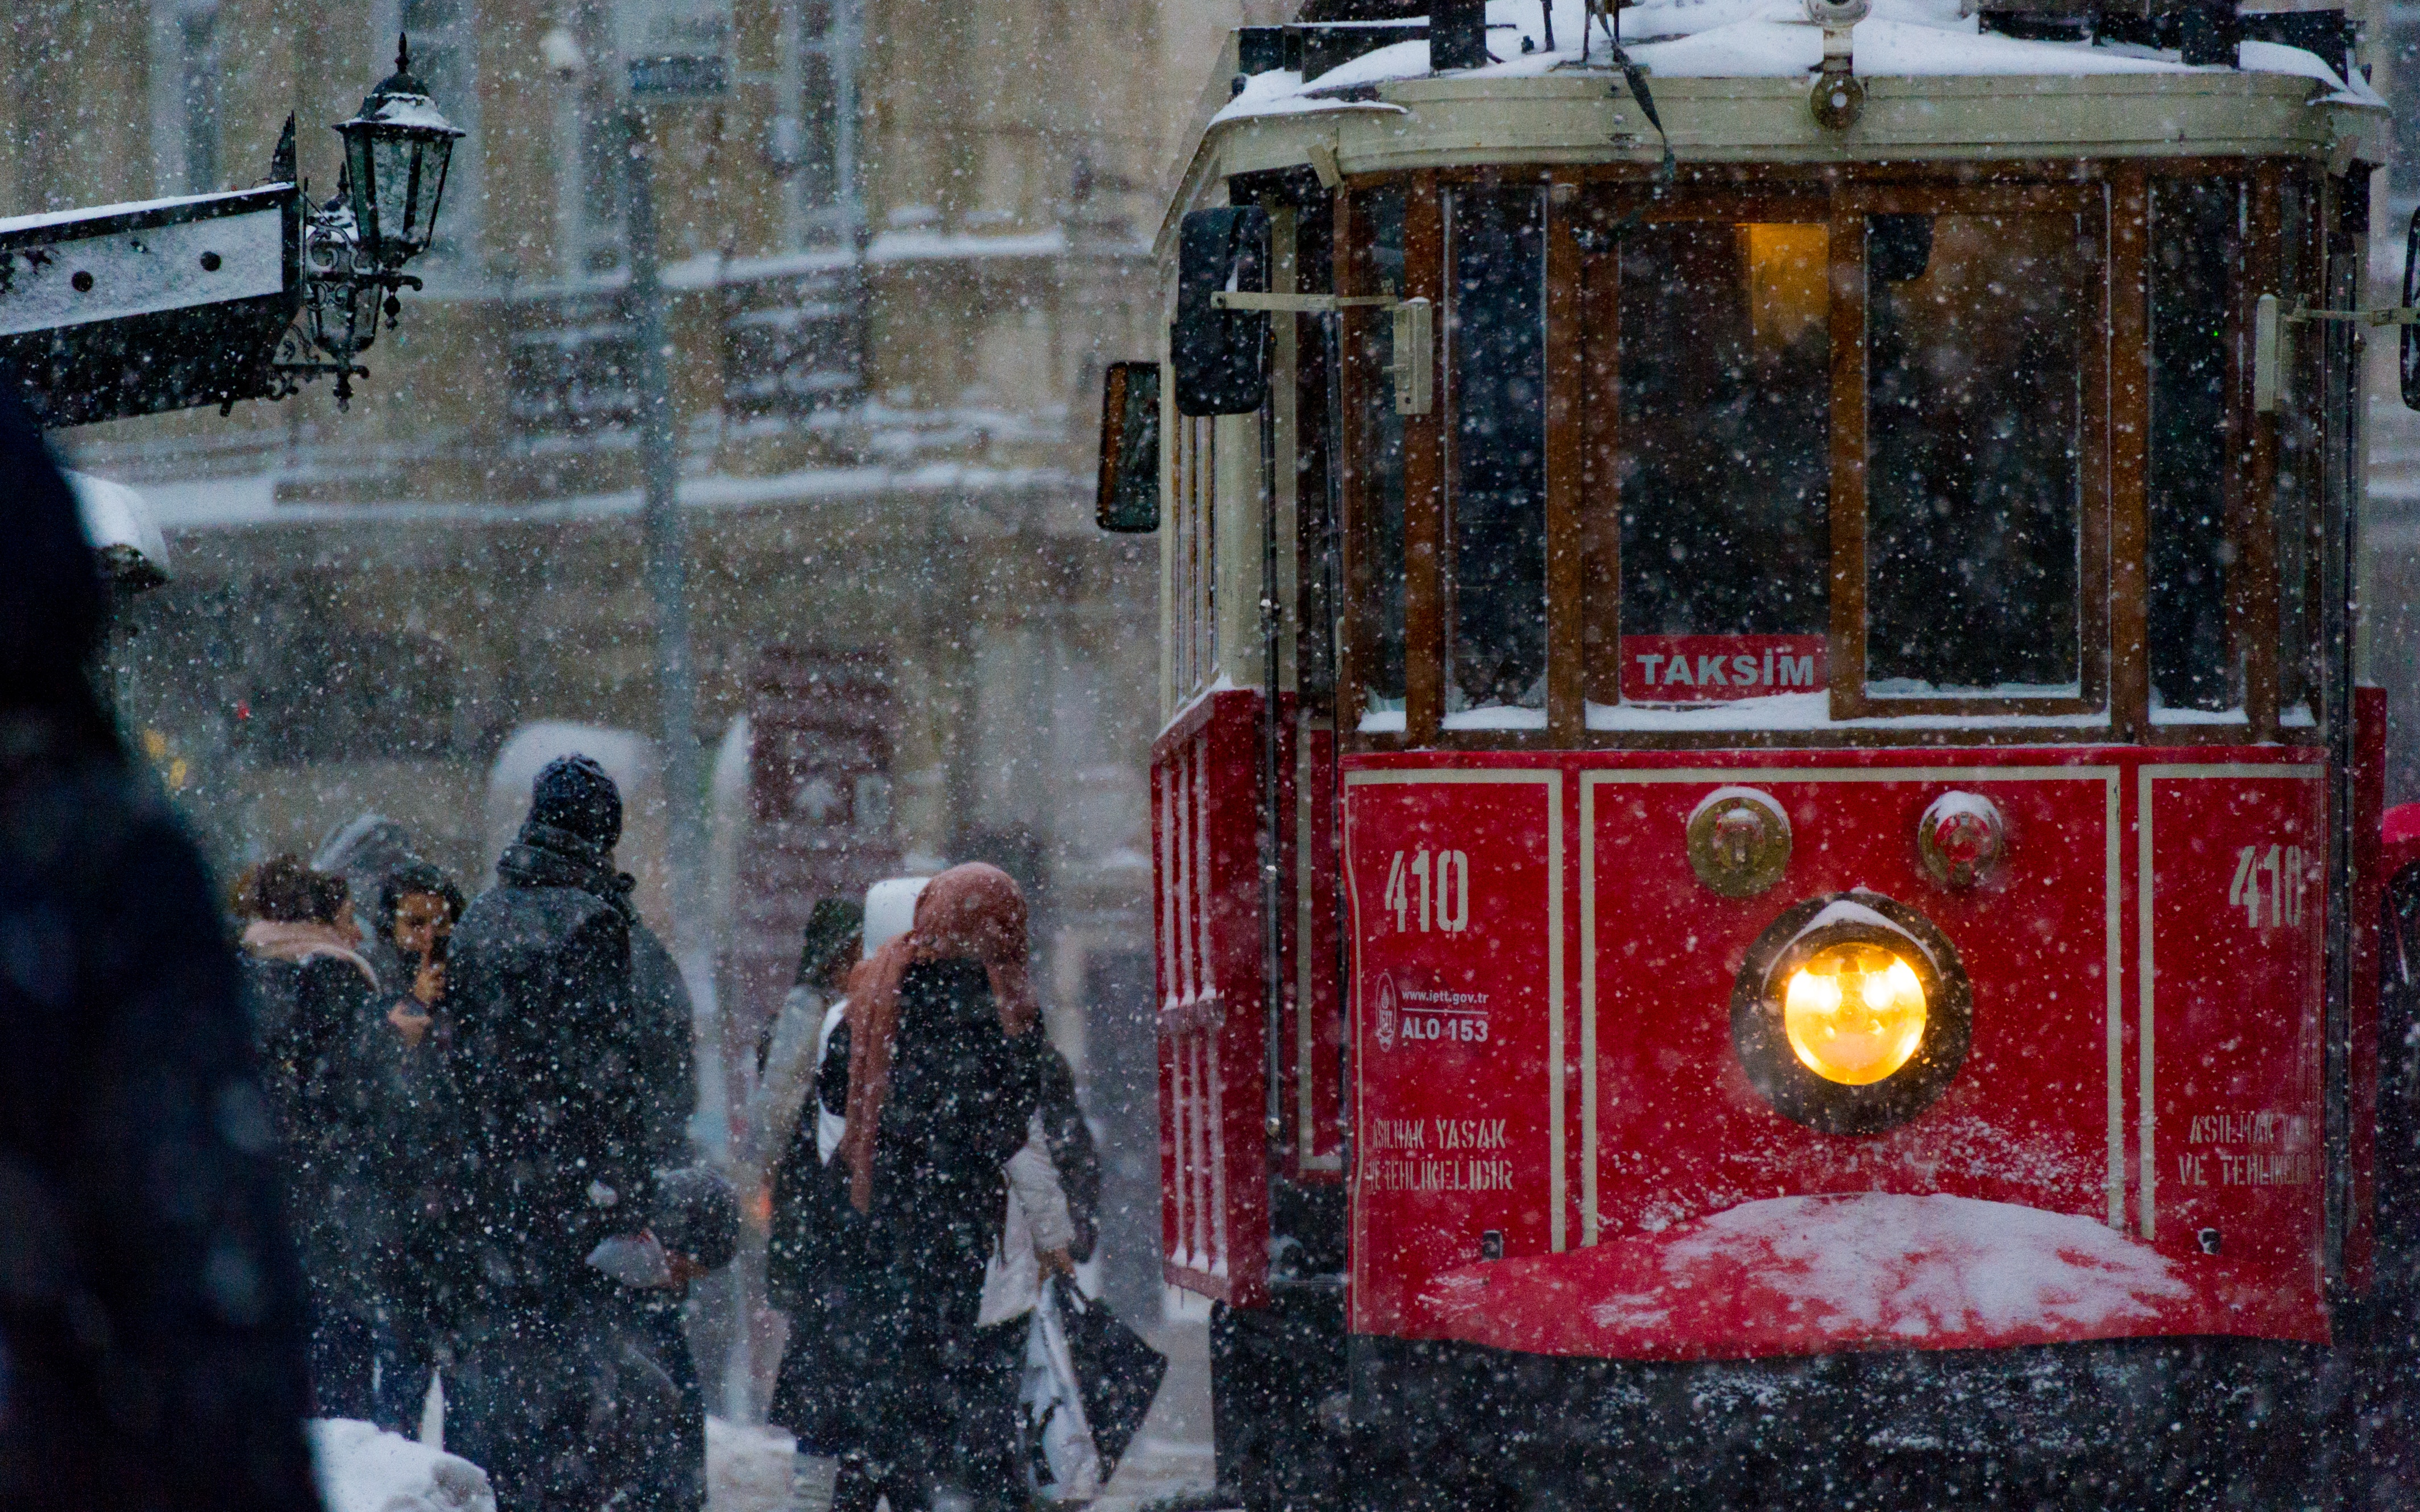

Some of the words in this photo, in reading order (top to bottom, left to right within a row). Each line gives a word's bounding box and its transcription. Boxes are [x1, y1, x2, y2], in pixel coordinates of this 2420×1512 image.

[1636, 648, 1813, 686] TAKSİM
[1385, 850, 1469, 932] 410
[2229, 845, 2301, 928] 410
[1402, 991, 1489, 1006] www.iett.gov.tr
[1402, 1017, 1440, 1040] ALO
[1448, 1019, 1489, 1042] 153
[1435, 1118, 1506, 1150] YASAK
[2178, 1154, 2208, 1186] VE
